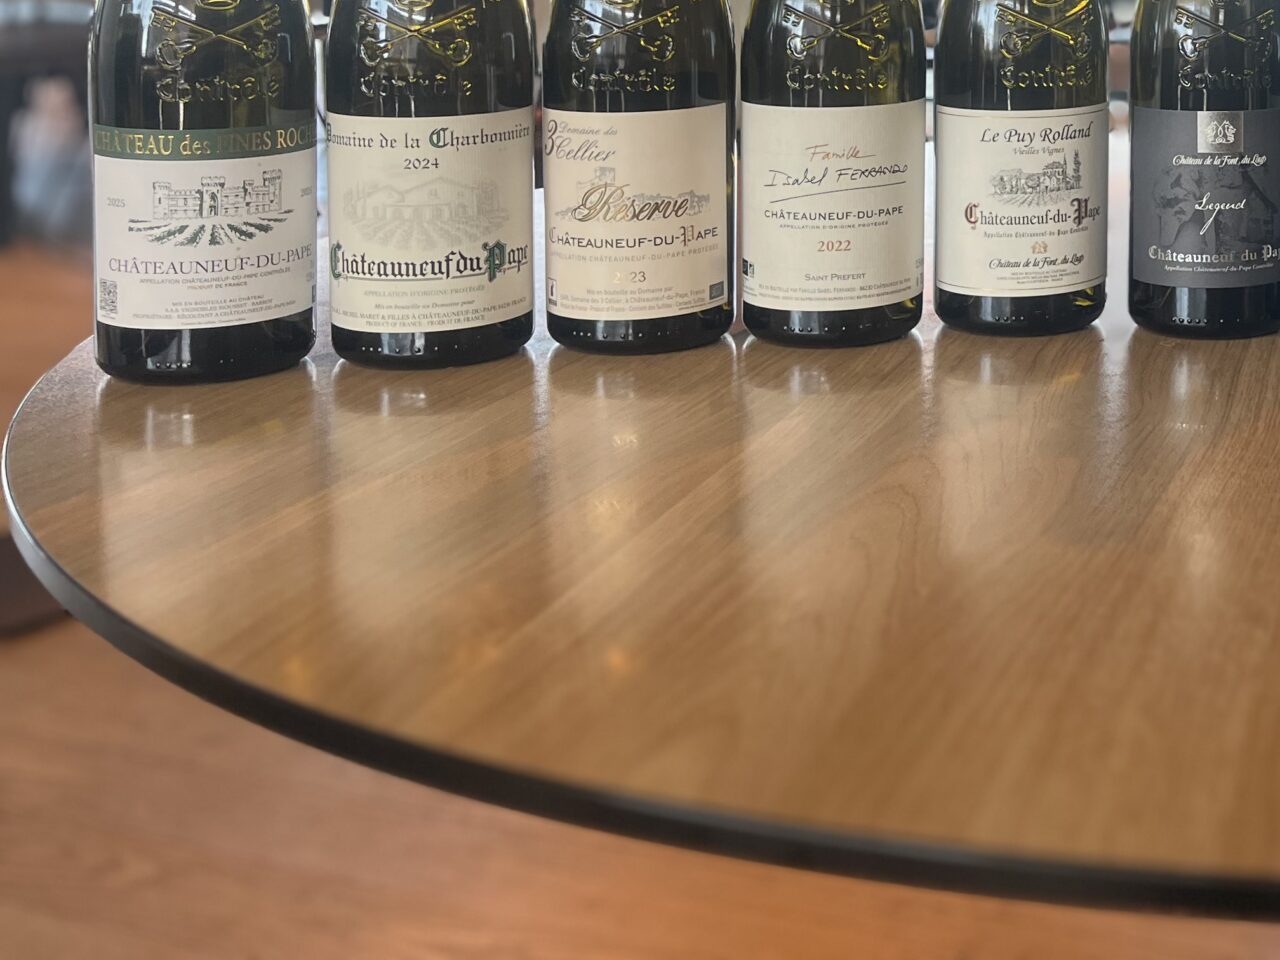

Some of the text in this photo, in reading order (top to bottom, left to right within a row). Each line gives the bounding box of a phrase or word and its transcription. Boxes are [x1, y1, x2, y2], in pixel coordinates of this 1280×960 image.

[379, 133, 398, 149] de
[405, 133, 421, 149] la
[544, 119, 558, 156] 3
[981, 121, 1094, 148] Le Puy Rolland
[179, 134, 211, 156] des
[806, 143, 876, 161] Famille
[1013, 146, 1065, 157] Vieilles Vignes
[403, 157, 440, 171] 2024
[571, 182, 690, 223] Réserve
[764, 205, 904, 221] CHÂTEAUNEUF-DU-PAPE
[1195, 192, 1247, 235] Legend
[549, 224, 719, 249] CHÂTEAUNEUF-DU-PAPE
[817, 239, 852, 252] 2022
[108, 243, 312, 275] CHÂTEAUNEUF-DU-PAPE
[456, 250, 482, 273] du
[1241, 249, 1258, 262] du
[613, 271, 647, 284] 223
